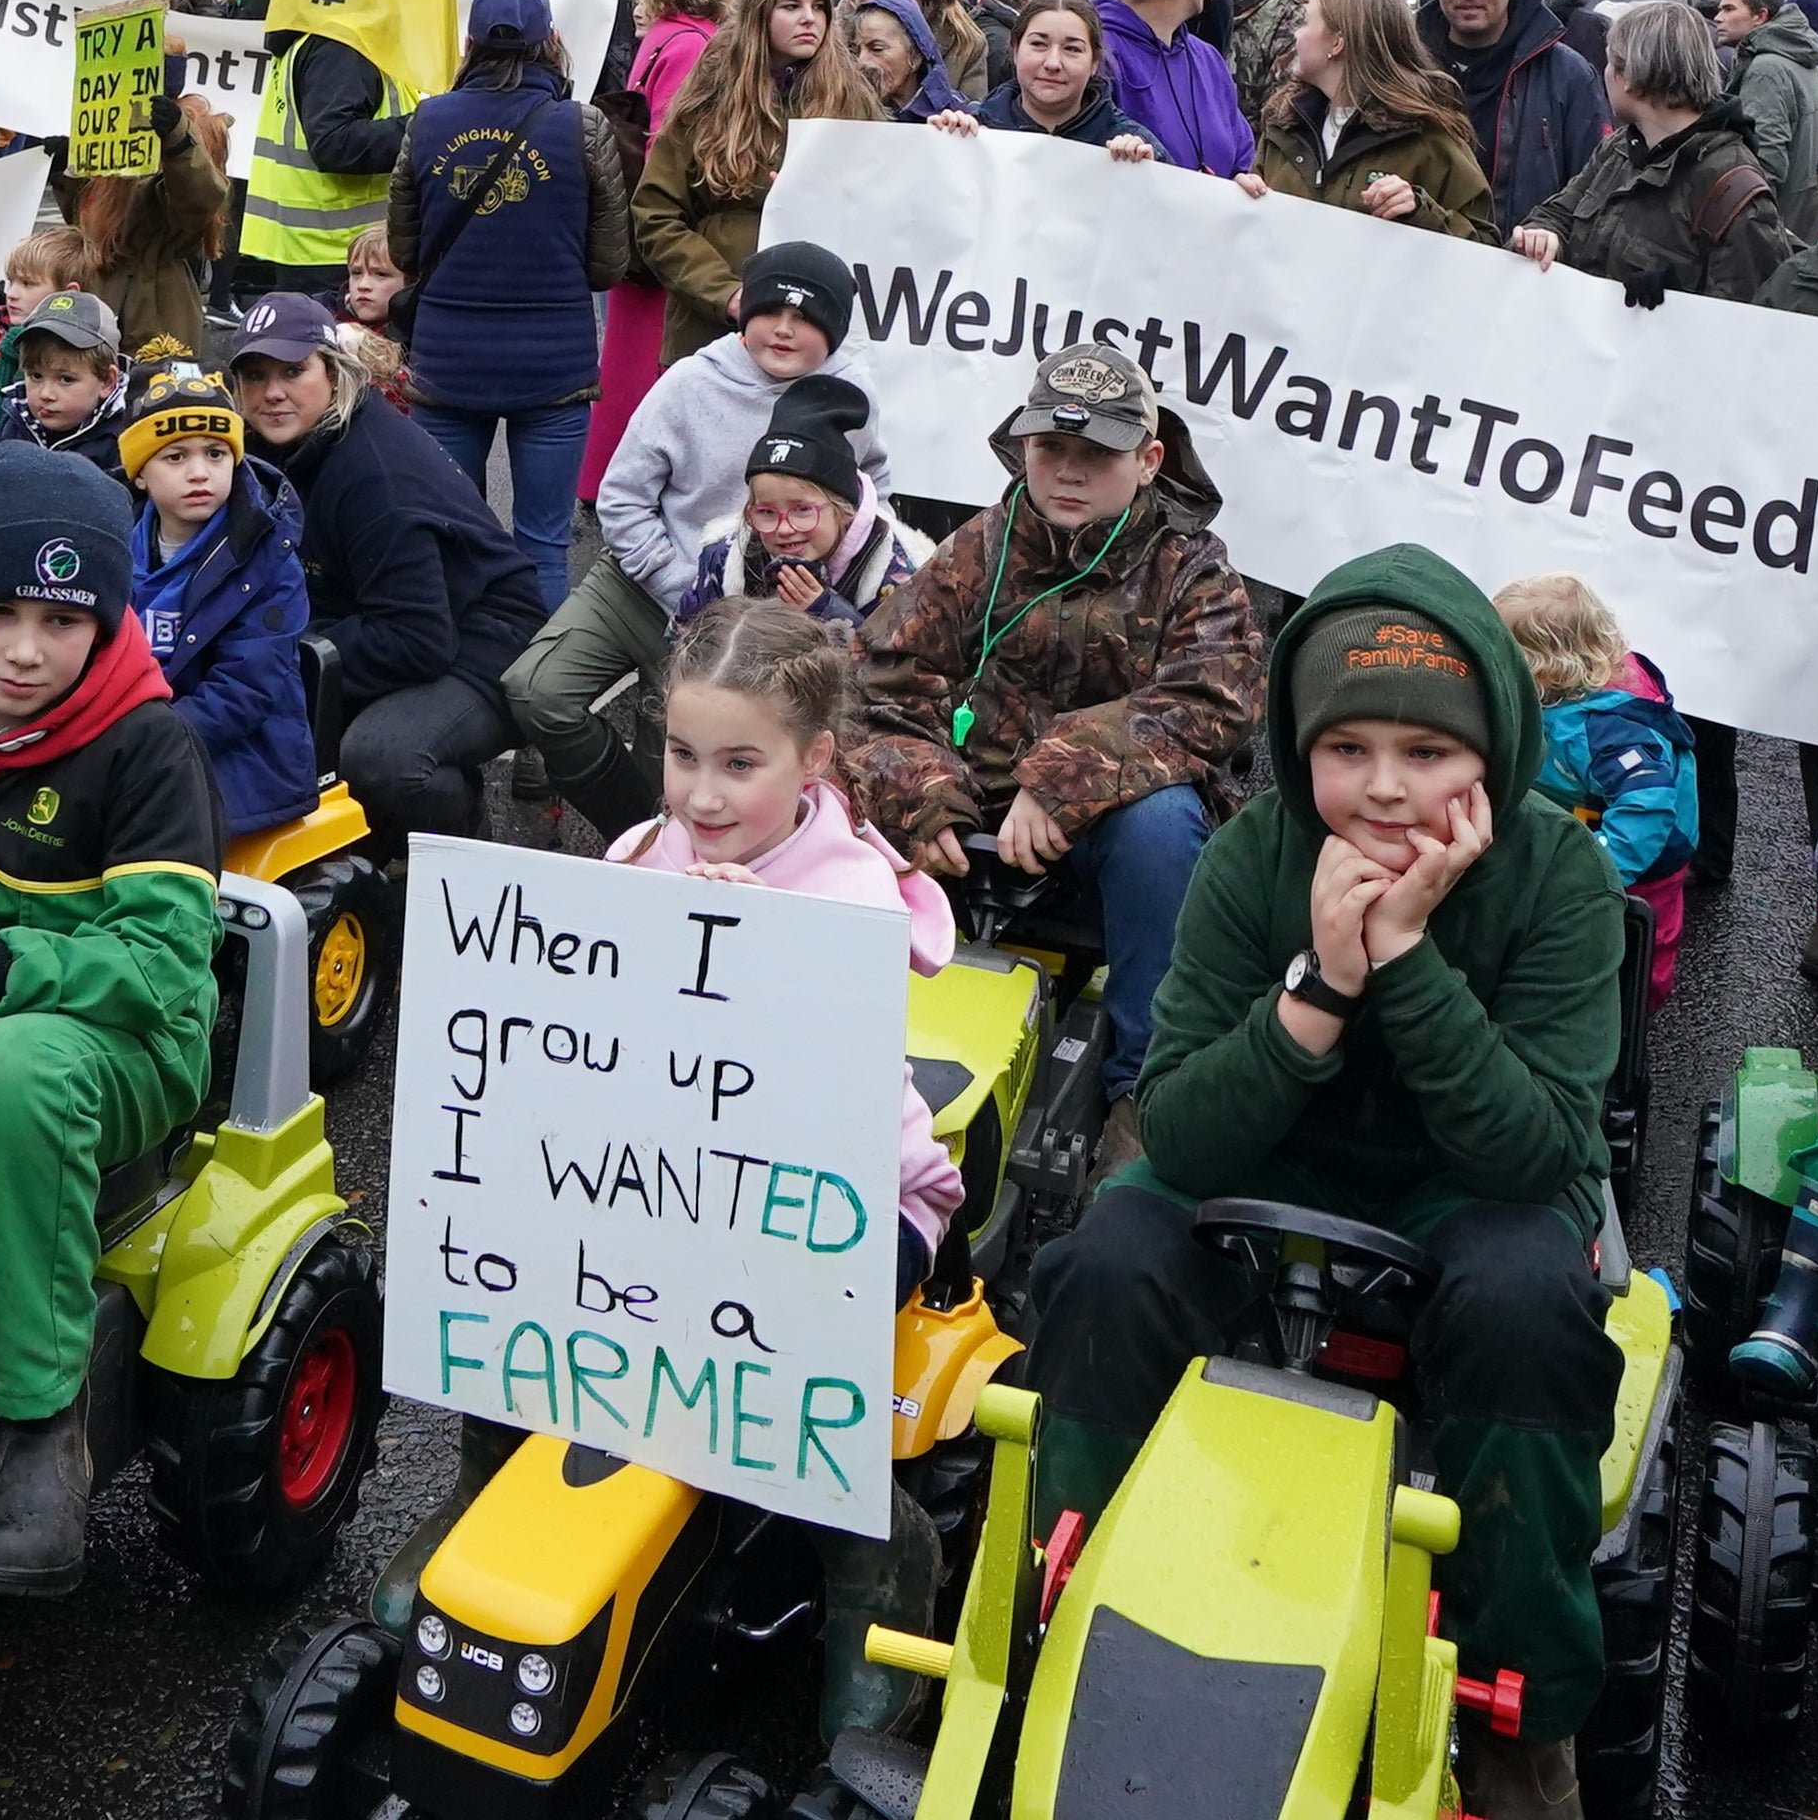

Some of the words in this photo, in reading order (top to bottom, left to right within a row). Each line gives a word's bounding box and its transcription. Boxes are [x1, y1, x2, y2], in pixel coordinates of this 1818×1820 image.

[80, 24, 125, 61] TRY
[136, 18, 156, 50] A
[80, 72, 122, 103] DAY
[132, 67, 160, 95] IN
[77, 106, 120, 137] OUR
[528, 149, 551, 181] SON
[1051, 367, 1076, 379] JOHN
[155, 415, 231, 437] JCB
[16, 585, 97, 607] GRASSMEN
[1375, 625, 1444, 648] #Save
[1, 818, 28, 836] JOHN
[27, 827, 65, 848] DEERE
[441, 877, 619, 978] When
[679, 913, 741, 1000] I
[448, 1008, 619, 1100] grow
[669, 1050, 754, 1121] up
[431, 1104, 481, 1184] I
[540, 1140, 868, 1252] WANTED
[439, 1216, 517, 1292] to
[576, 1239, 659, 1322] be
[710, 1300, 776, 1353] a
[439, 1310, 867, 1493] FARMER
[893, 1395, 920, 1418] CB
[461, 1642, 503, 1671] JCB
